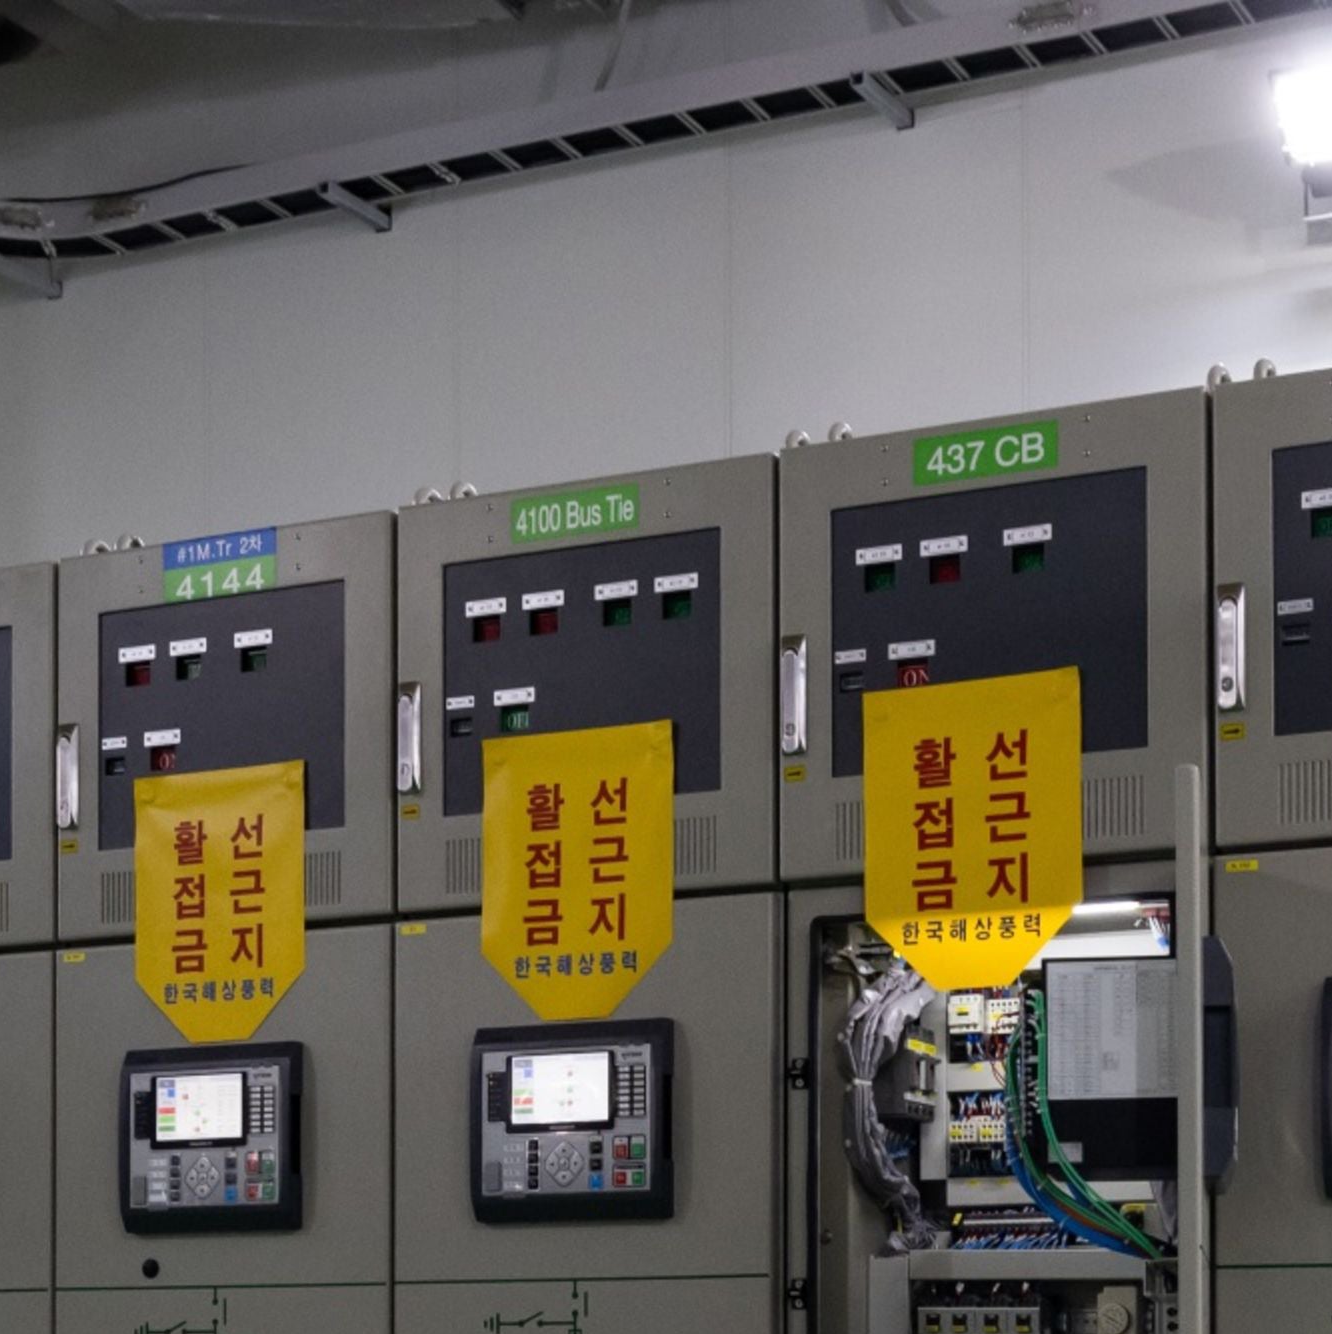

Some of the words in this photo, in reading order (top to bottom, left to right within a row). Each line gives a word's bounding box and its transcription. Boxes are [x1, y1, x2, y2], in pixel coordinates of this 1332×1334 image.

[926, 440, 985, 475] 437
[993, 432, 1045, 466] CB
[515, 502, 561, 536] 4100
[565, 497, 602, 530] Bus
[605, 493, 634, 525] Tie
[176, 540, 233, 564] #1M.Tr
[239, 533, 263, 555] 2차
[175, 563, 265, 601] 4144
[901, 914, 1041, 946] 한국해상풍력
[514, 950, 638, 980] 한국해상풍력
[163, 978, 274, 1005] 한국해상풍력
